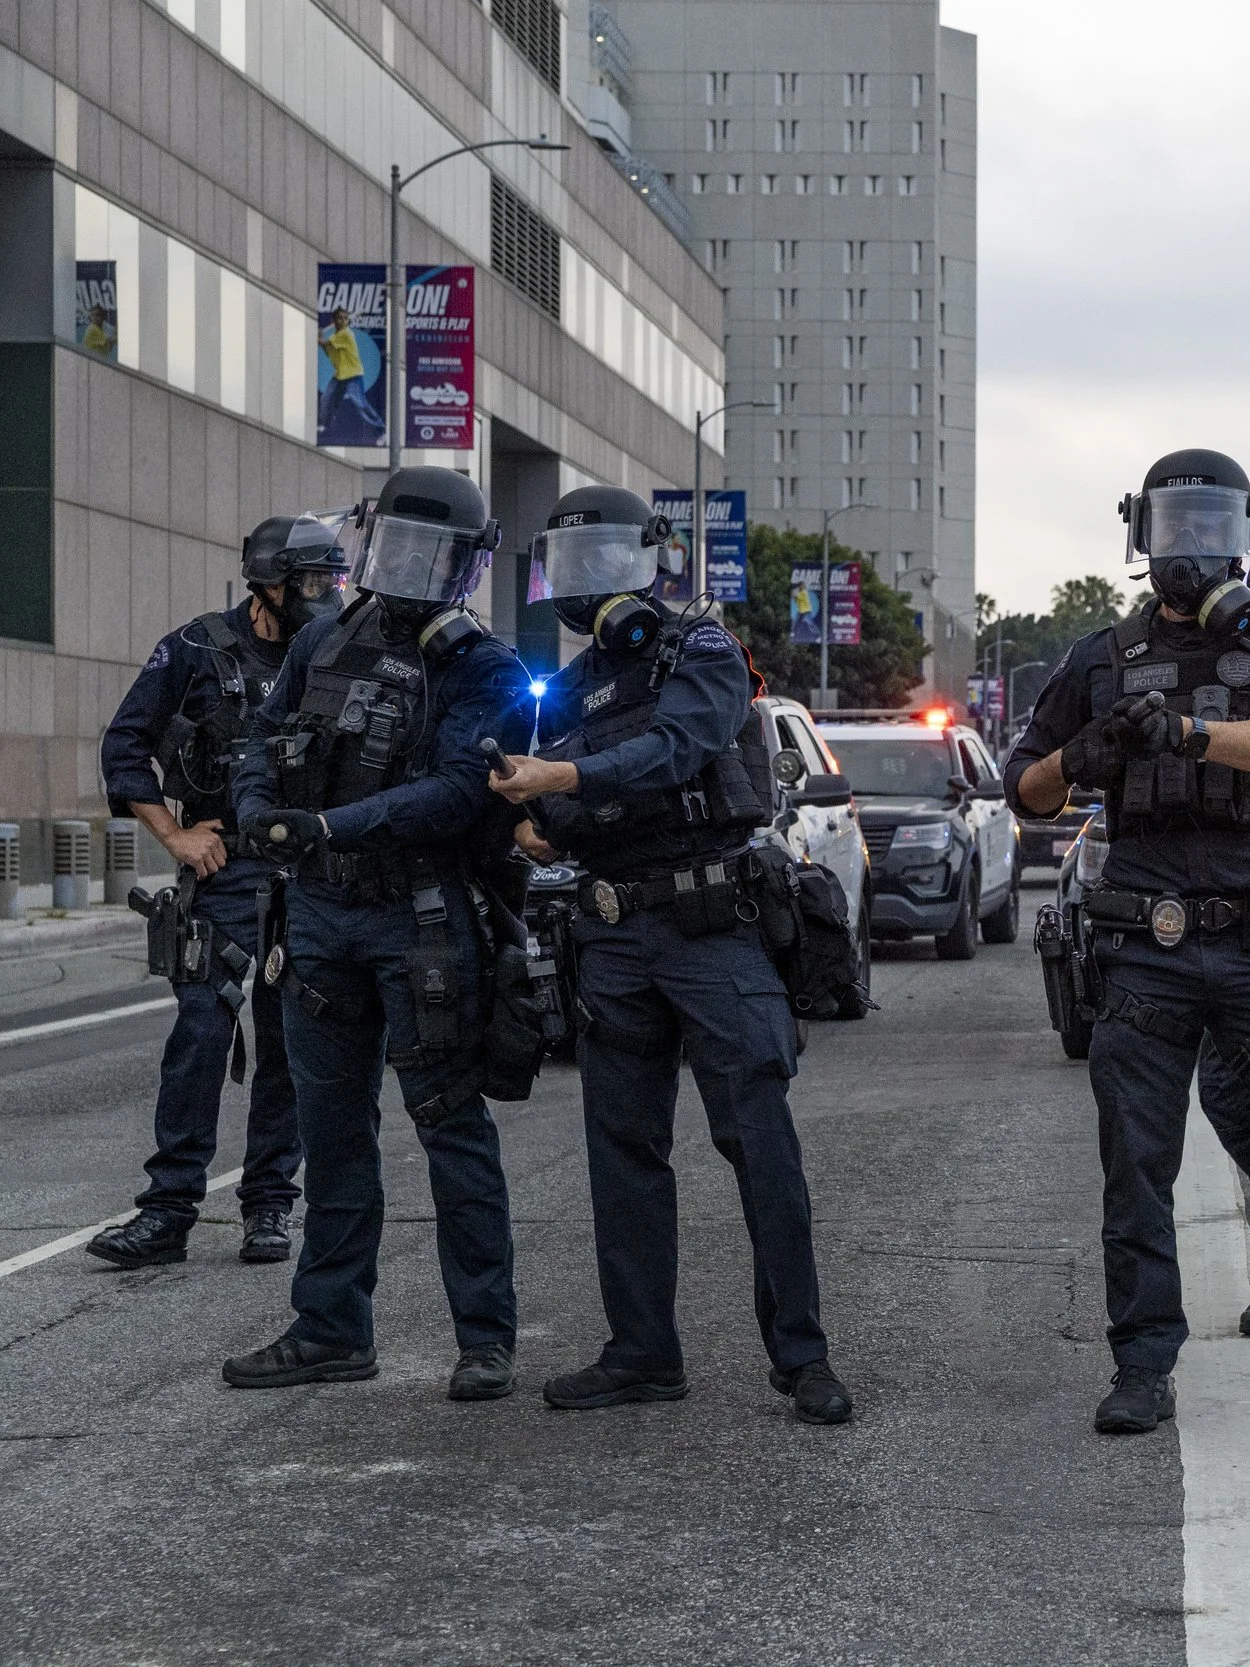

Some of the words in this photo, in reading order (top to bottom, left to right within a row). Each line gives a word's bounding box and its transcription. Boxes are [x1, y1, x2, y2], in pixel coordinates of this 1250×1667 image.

[319, 282, 387, 315] GAME
[406, 284, 450, 316] ON!
[406, 317, 439, 331] SPORTS
[447, 318, 470, 332] PLAY
[654, 501, 693, 520] GAME
[706, 501, 732, 520] ON!
[559, 513, 584, 527] LOPEZ
[700, 641, 728, 649] POLICE
[382, 656, 395, 665] LOS
[394, 661, 421, 676] ANGELES
[382, 664, 413, 680] POLICE
[1127, 672, 1142, 680] LOS
[1143, 667, 1174, 678] ANGELES
[1133, 675, 1168, 687] POLICE
[583, 693, 594, 705] LOS
[588, 691, 611, 711] POLICE
[532, 868, 562, 881] Ford
